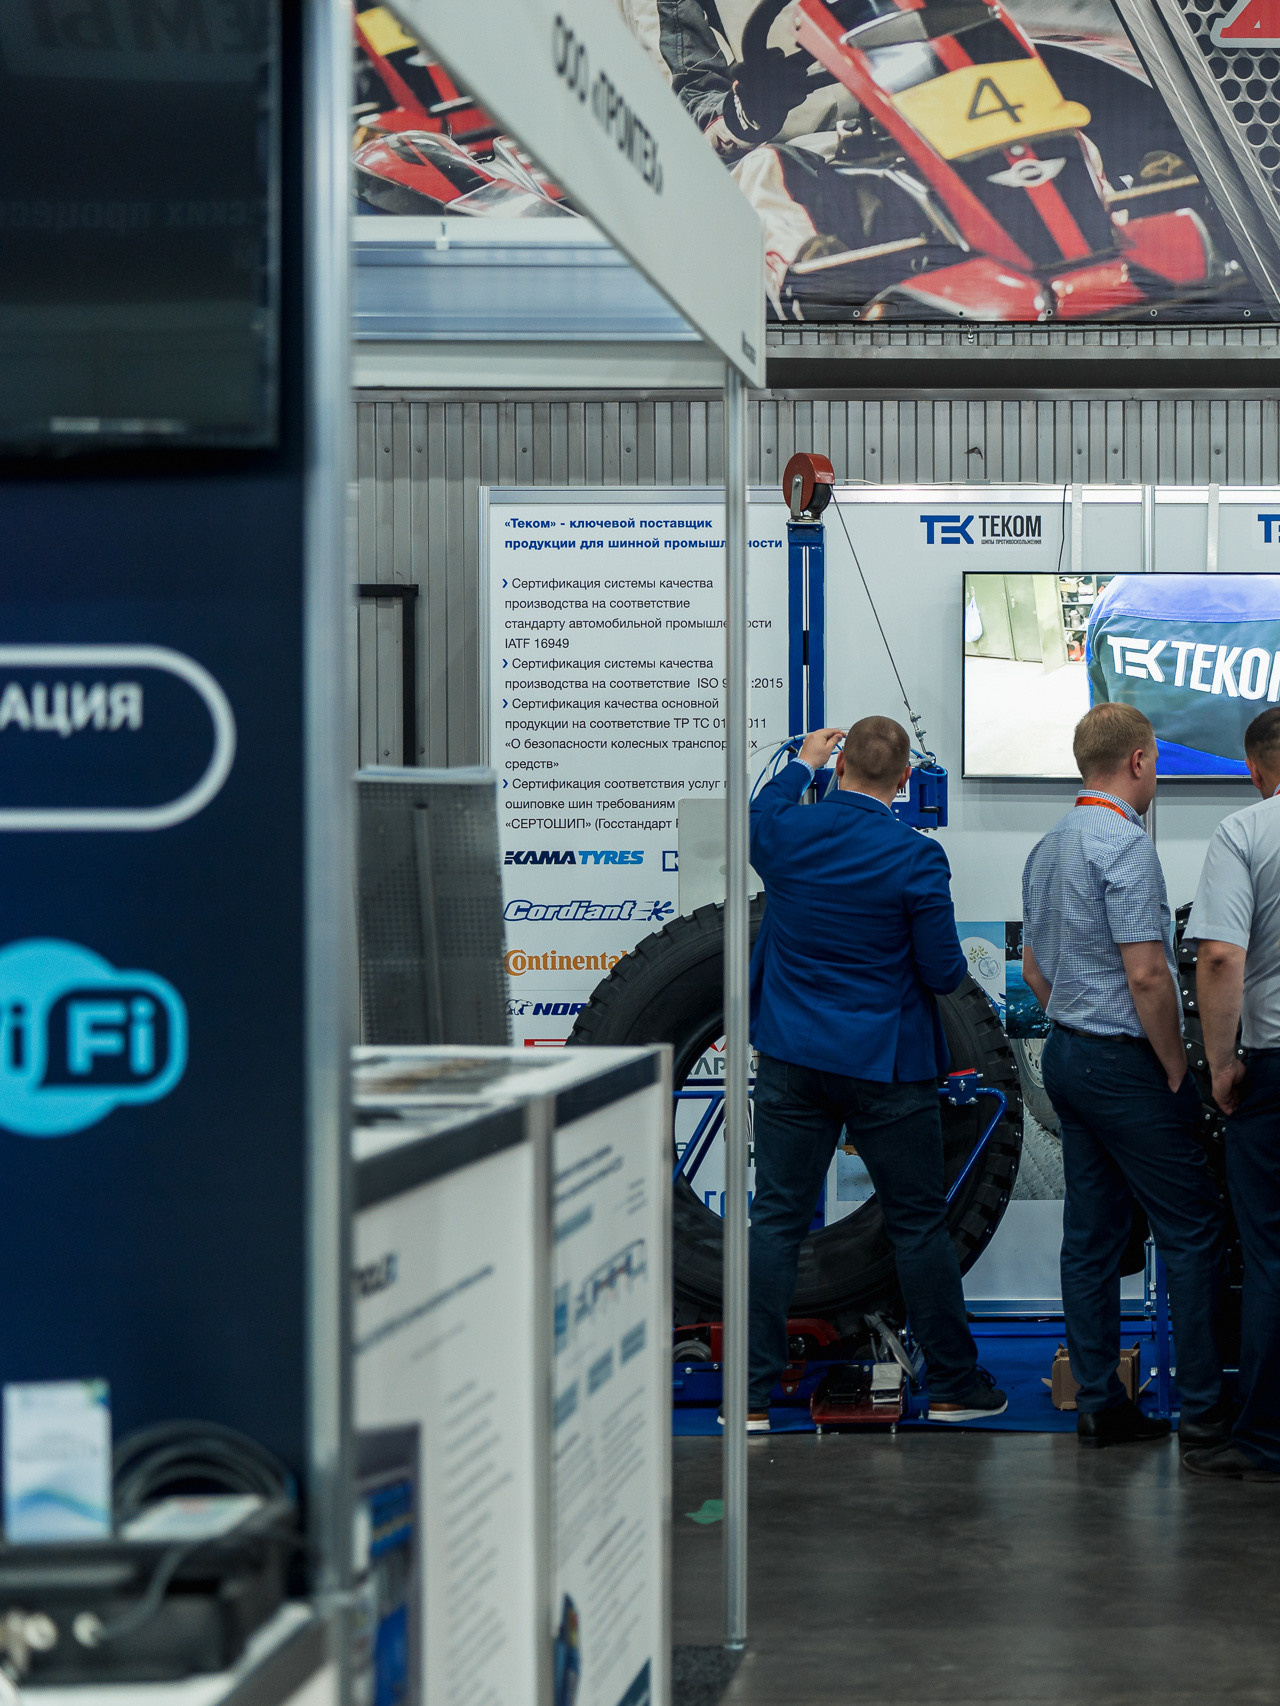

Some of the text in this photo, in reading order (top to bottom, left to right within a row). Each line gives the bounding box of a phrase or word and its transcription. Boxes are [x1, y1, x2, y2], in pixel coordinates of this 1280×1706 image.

[967, 77, 1024, 123] 4
[504, 517, 713, 530] «Теком» ключевой поставщик
[978, 515, 1042, 537] ТЕКОМ
[504, 540, 576, 551] продукции
[579, 540, 604, 550] для
[608, 537, 660, 549] шинной
[511, 577, 714, 591] Сертификация системы качества
[504, 599, 691, 611] производства на соответствие
[504, 620, 566, 632] стандарту
[568, 617, 662, 629] автомобильной
[505, 637, 570, 649] IATF 16949
[511, 657, 714, 672] Сертификация системы качества
[505, 677, 784, 692] производства на соответствие ISO 9:2015
[0, 681, 144, 738] АЦИЯ
[511, 697, 719, 712] Сертификация качества основной
[505, 717, 768, 732] продукции на соответствие ТР ТС 01011
[524, 738, 608, 749] безопасности
[610, 740, 669, 749] колесных
[504, 760, 560, 772] средств»
[512, 778, 601, 792] Сертификация
[604, 780, 685, 789] соответствия
[687, 780, 721, 792] услуг
[505, 798, 676, 812] ошиповке шин требованиям
[505, 818, 592, 830] «СЕРТОШИП»
[594, 818, 673, 832] (Госстандарт
[578, 850, 645, 865] TYRES
[503, 899, 638, 922] Cordiant
[66, 997, 155, 1075] Fi
